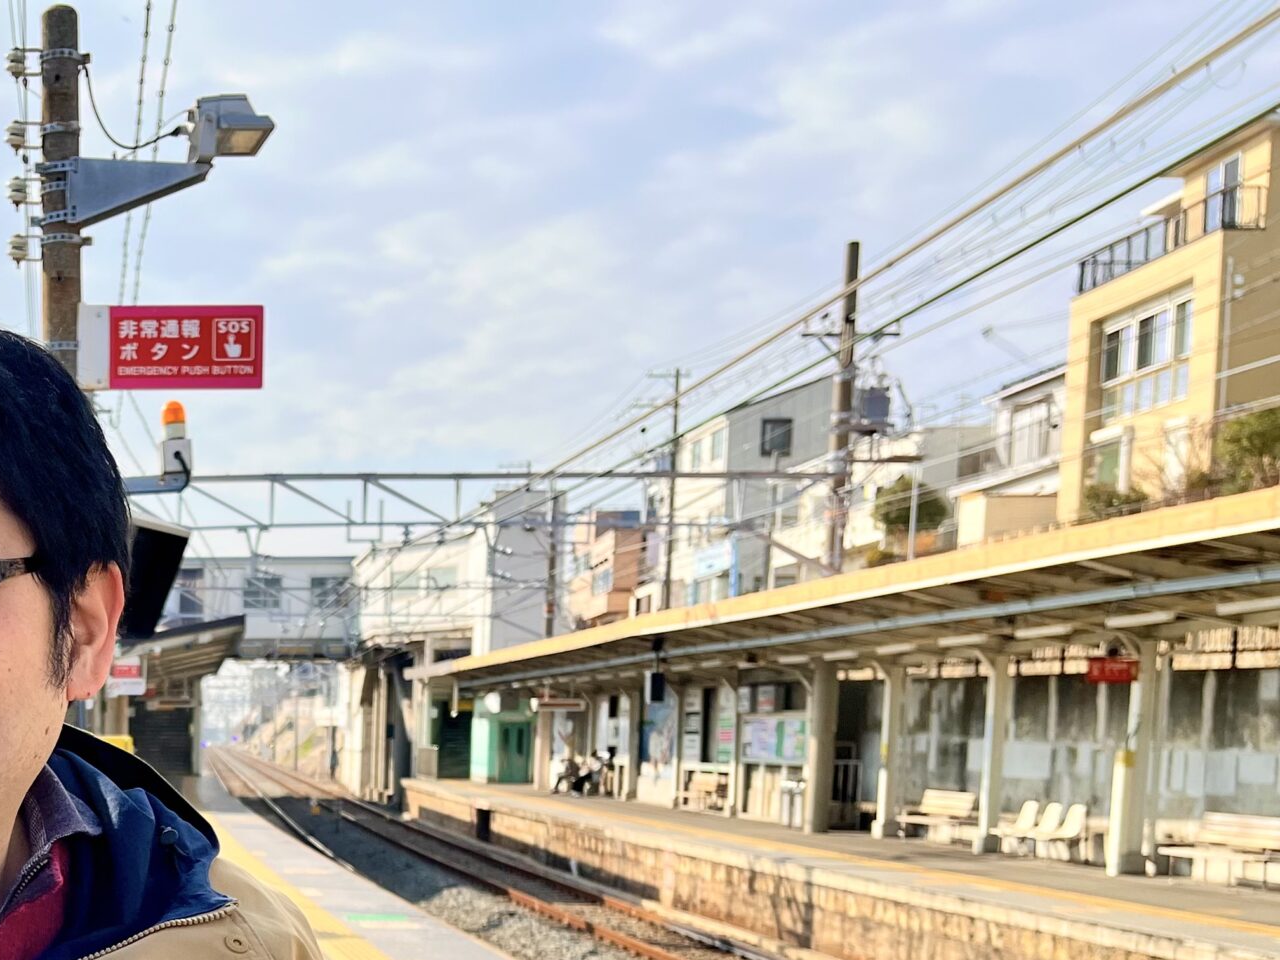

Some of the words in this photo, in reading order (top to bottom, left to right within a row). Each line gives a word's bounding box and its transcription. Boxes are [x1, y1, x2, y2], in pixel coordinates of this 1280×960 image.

[118, 319, 200, 339] 非常通報
[217, 320, 250, 334] SOS
[119, 342, 200, 361] ボタン
[117, 365, 179, 376] EMERGENCY
[180, 365, 210, 376] PUSH
[211, 365, 254, 375] BUTTON
